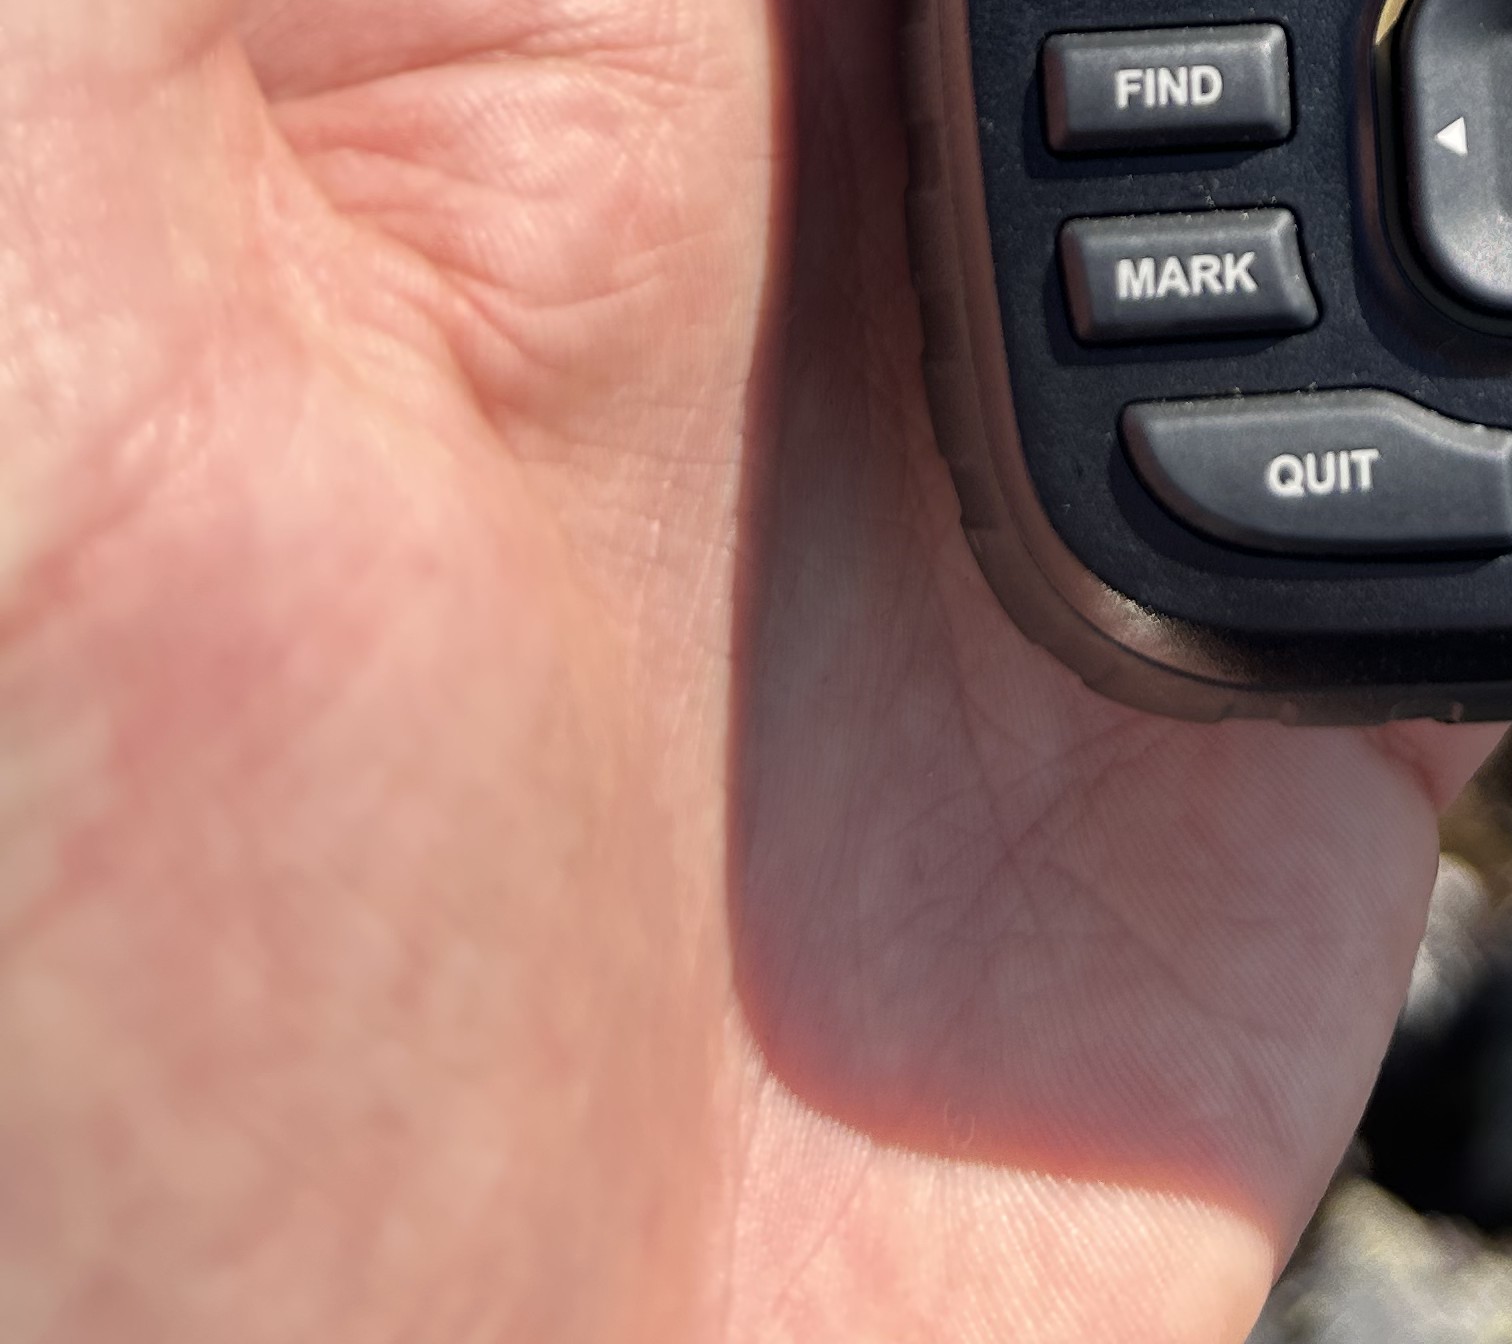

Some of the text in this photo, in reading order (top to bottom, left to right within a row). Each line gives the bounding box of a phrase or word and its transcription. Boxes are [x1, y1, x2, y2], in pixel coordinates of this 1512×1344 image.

[1115, 65, 1224, 110] FIND
[1116, 251, 1260, 301] MARK
[1265, 448, 1380, 498] QUIT
